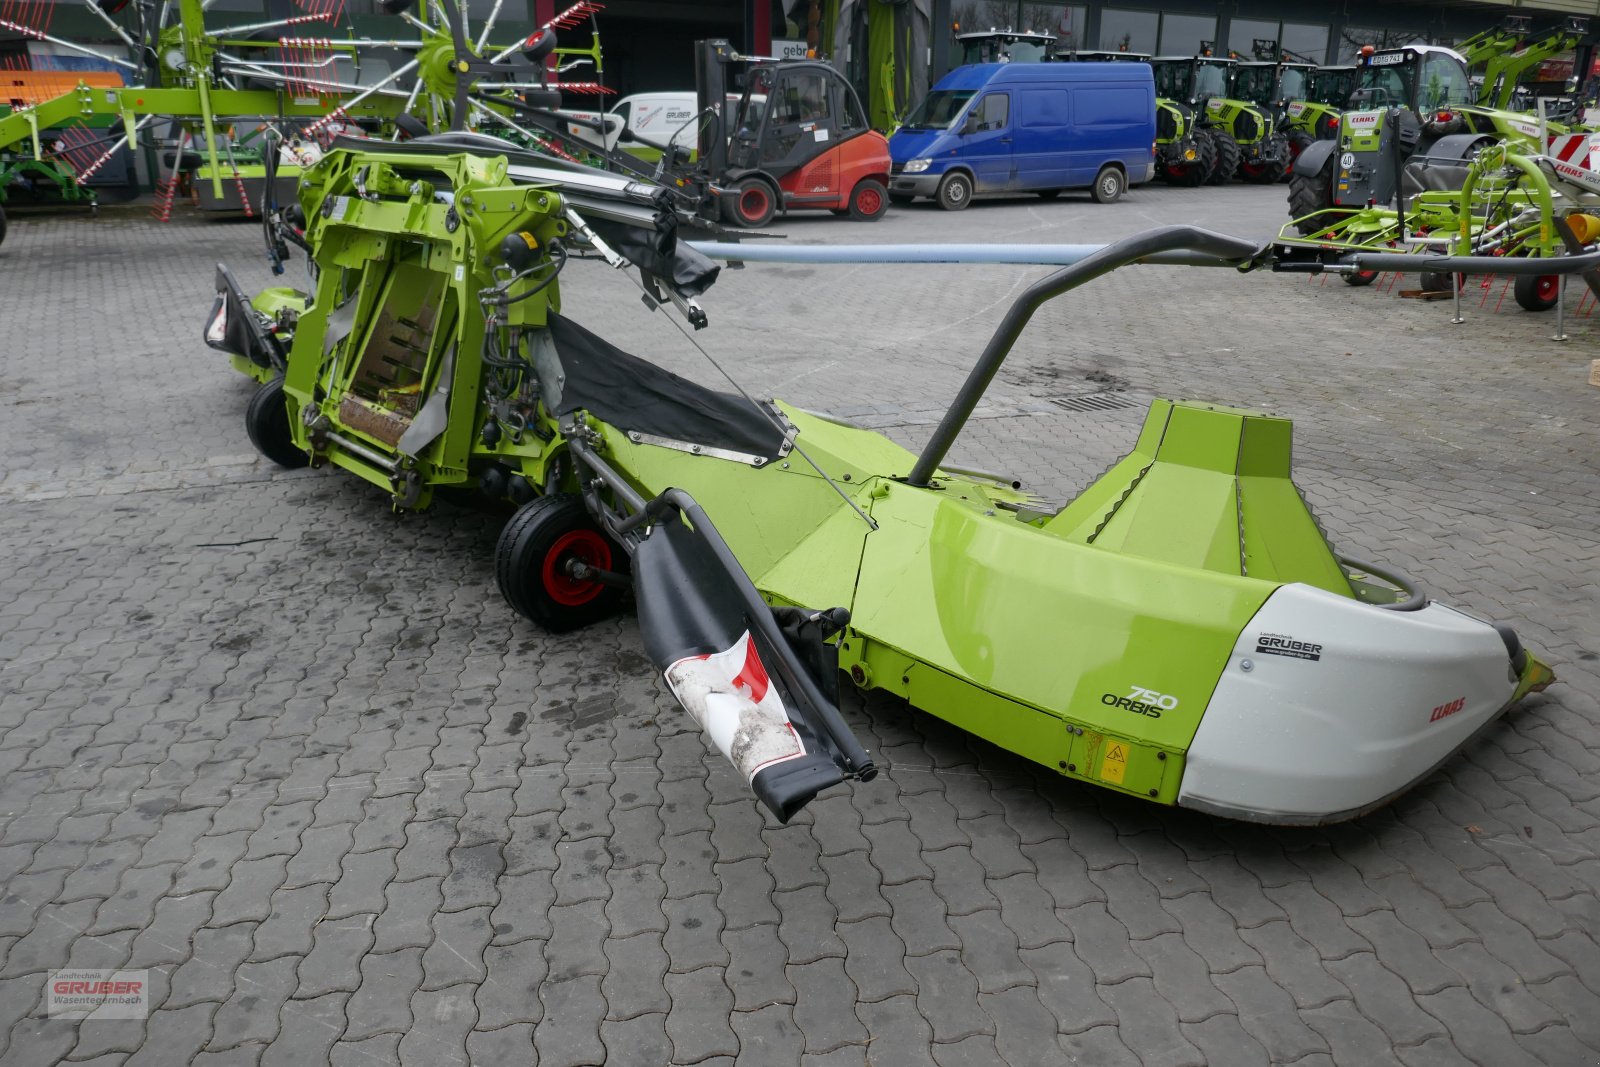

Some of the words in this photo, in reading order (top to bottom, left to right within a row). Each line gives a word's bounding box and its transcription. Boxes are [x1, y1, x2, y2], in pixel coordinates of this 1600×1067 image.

[666, 111, 691, 119] GRUBER
[1351, 116, 1376, 124] CLAAS
[1343, 155, 1353, 166] 40
[1555, 164, 1585, 178] CLAAS
[1258, 637, 1323, 654] GRUBER
[1126, 685, 1179, 710] 750
[1101, 693, 1164, 719] ORBIS
[1429, 695, 1466, 723] CLAAS
